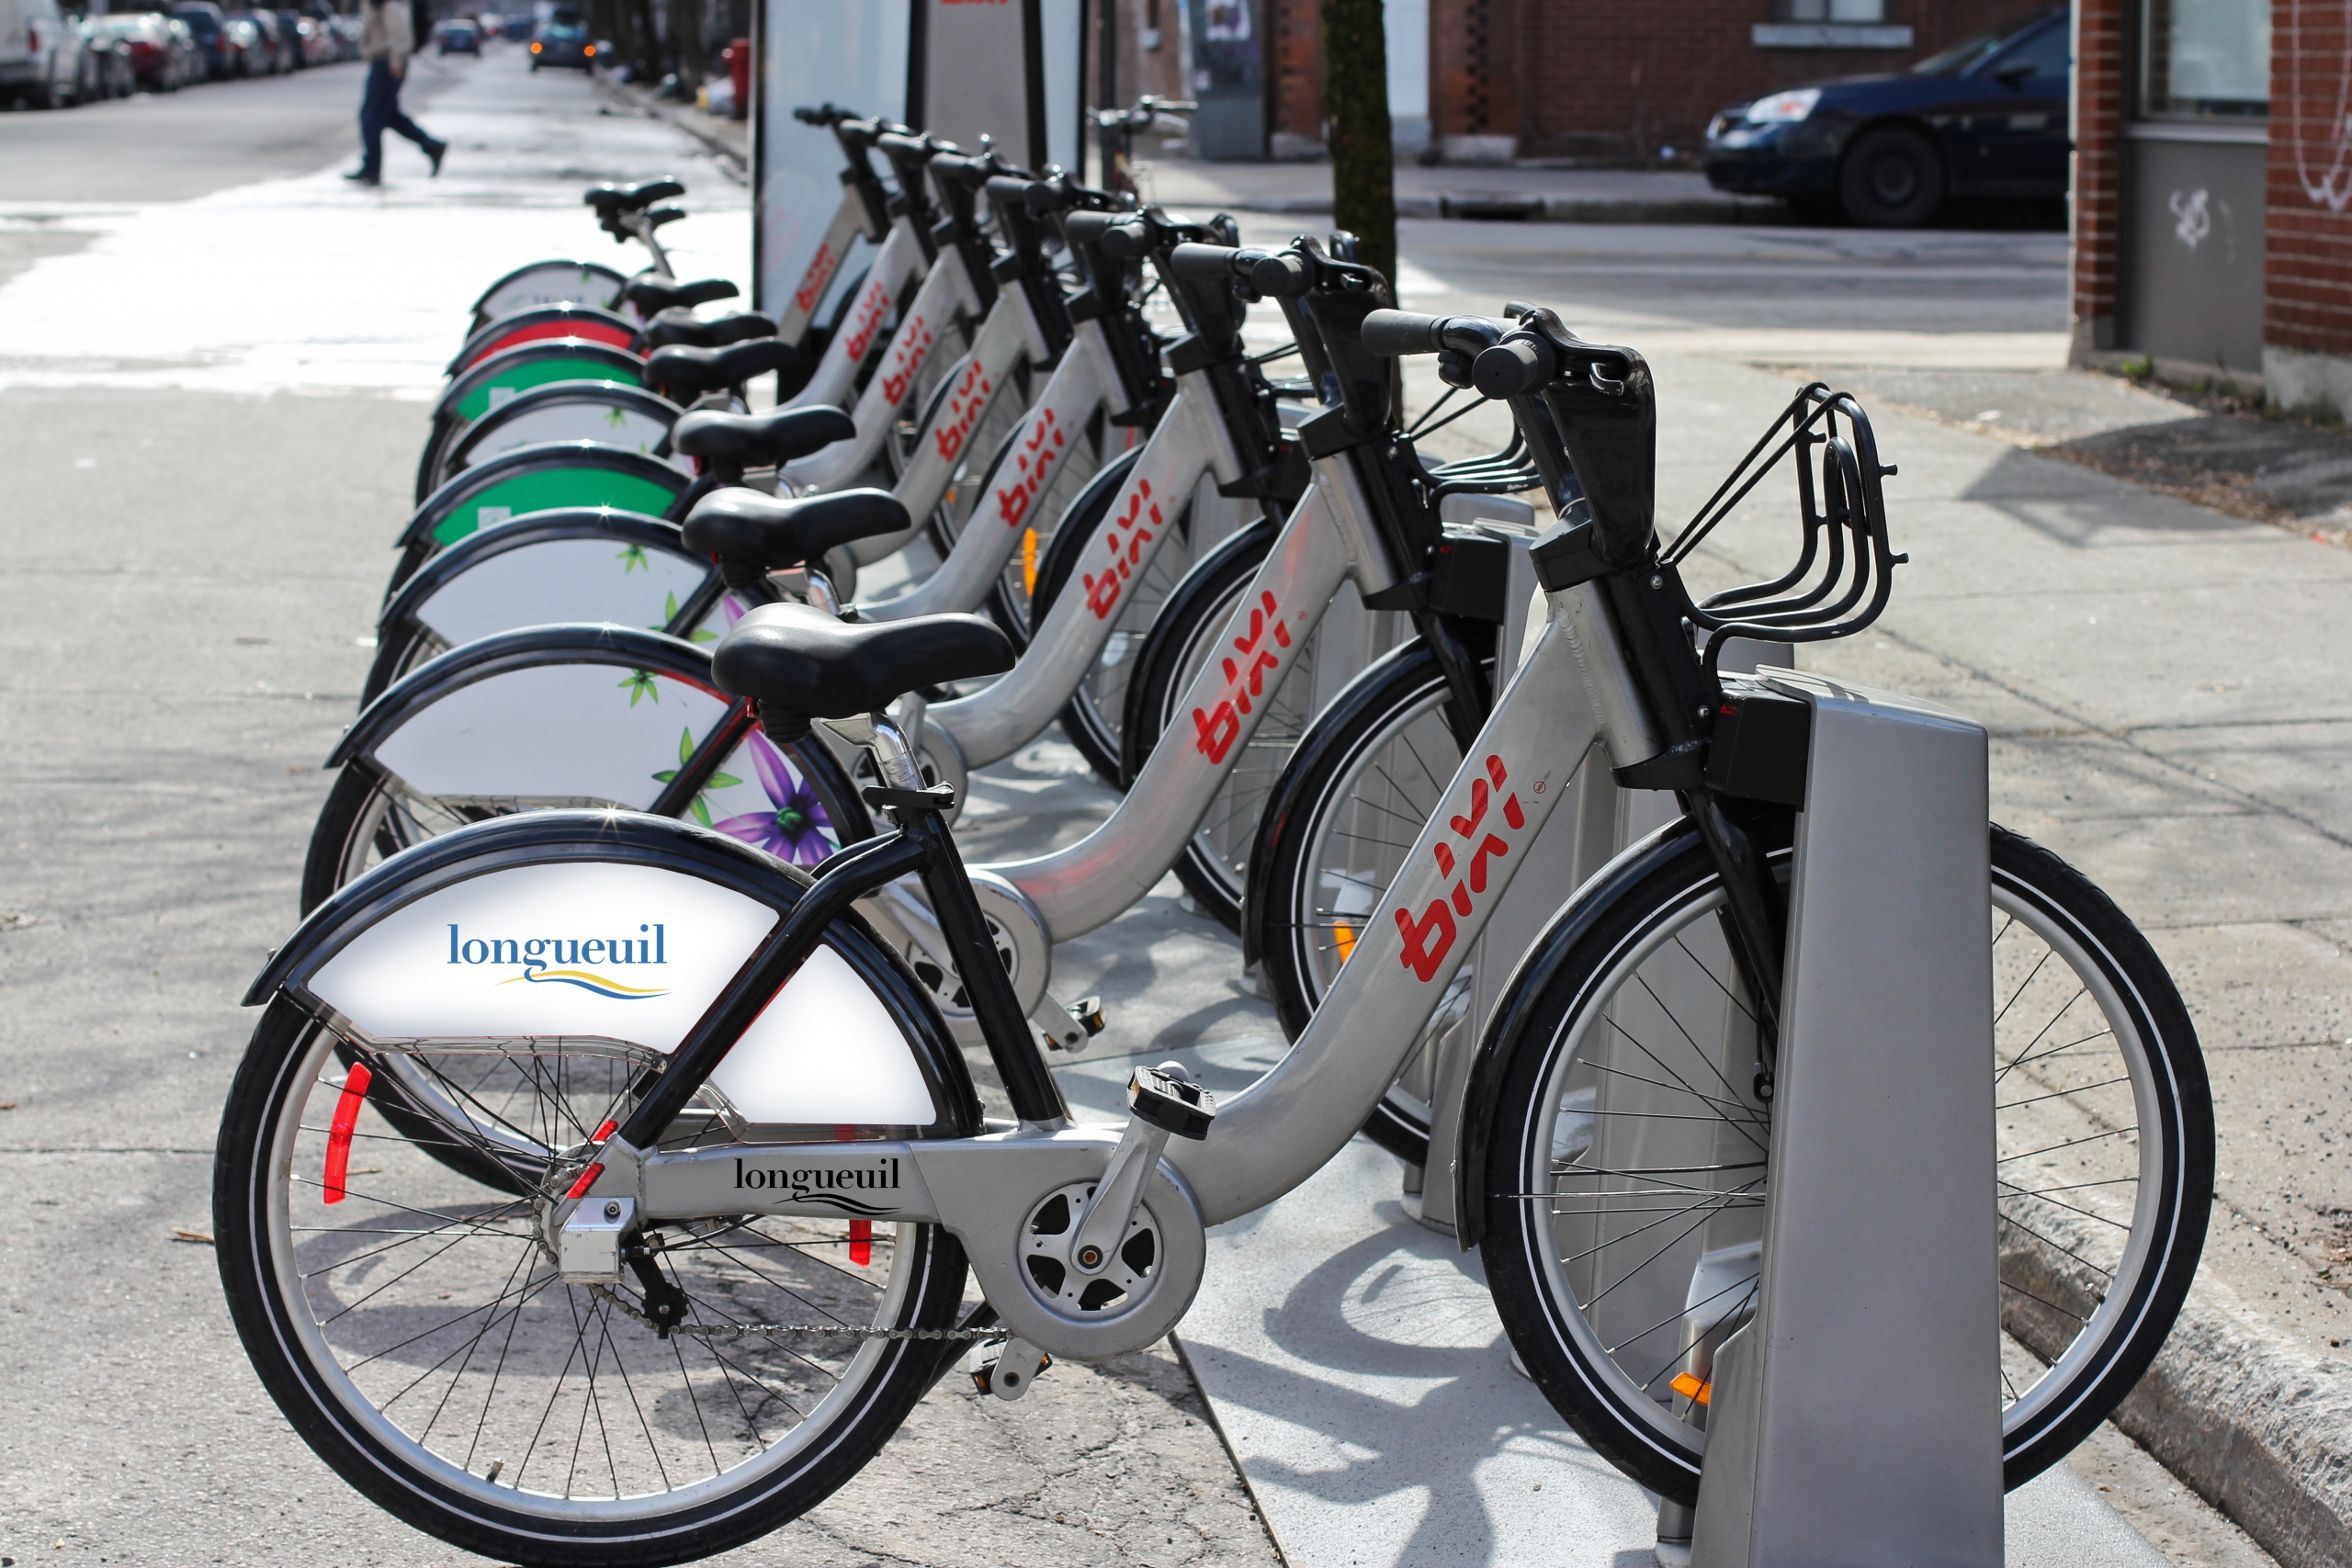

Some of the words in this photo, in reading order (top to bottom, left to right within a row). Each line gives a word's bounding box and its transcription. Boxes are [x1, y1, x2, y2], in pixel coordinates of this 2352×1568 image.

[934, 359, 991, 464] bixi
[998, 407, 1065, 527] bixi
[1082, 478, 1163, 621] bixi
[1193, 591, 1291, 765] bixi
[1395, 754, 1525, 983] bixi
[447, 923, 667, 983] longueuil
[734, 1157, 900, 1202] longueuil
